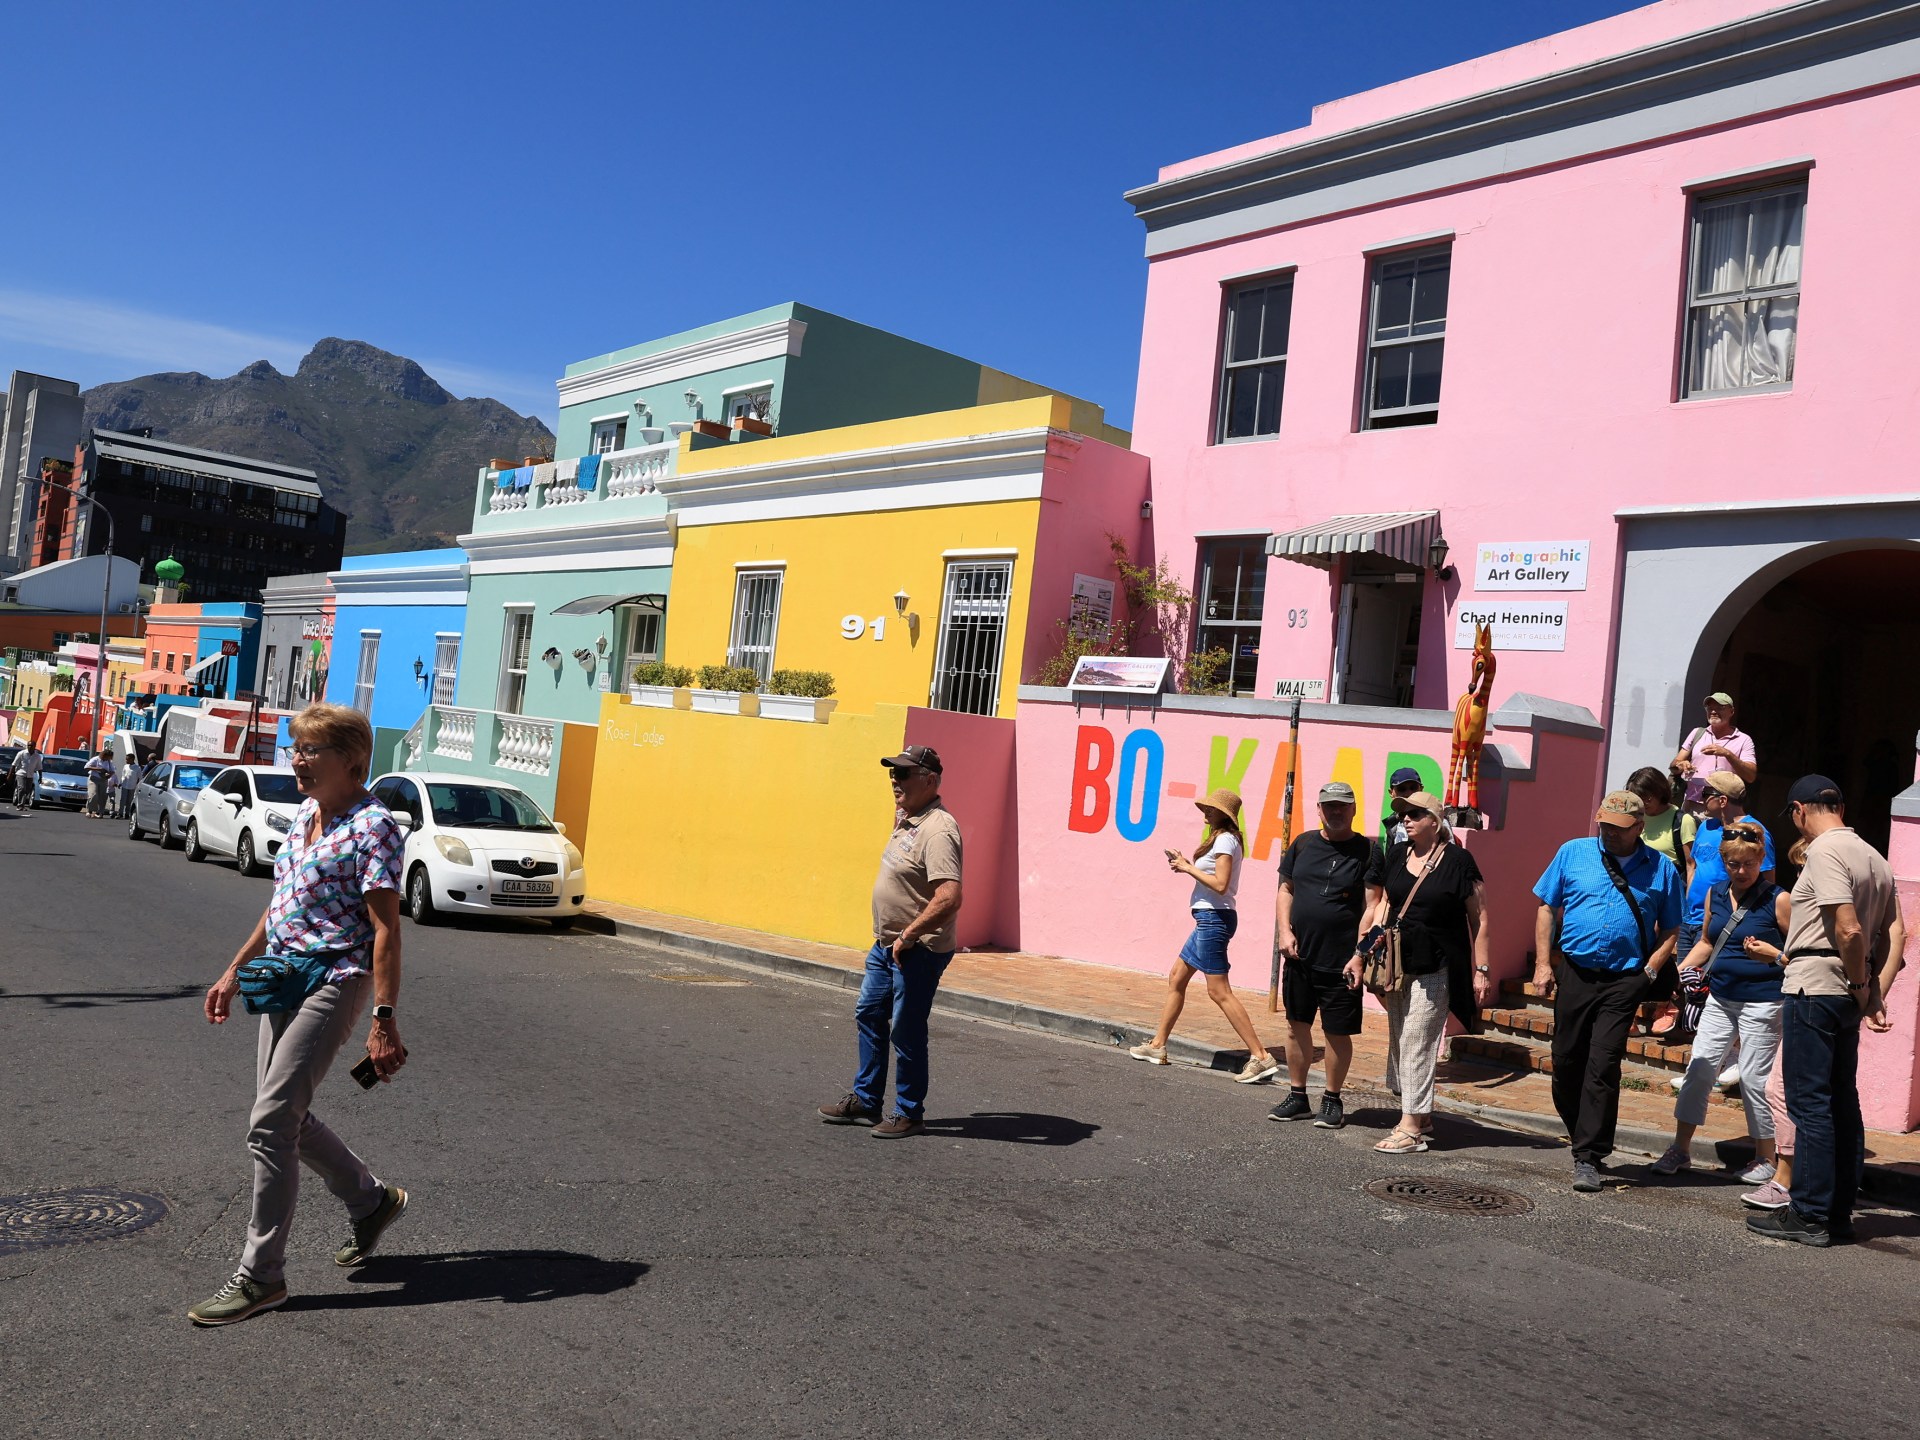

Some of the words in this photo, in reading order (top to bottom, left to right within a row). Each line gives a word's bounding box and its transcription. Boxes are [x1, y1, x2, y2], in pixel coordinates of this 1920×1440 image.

[1482, 549, 1581, 565] Photographic
[1488, 568, 1510, 581] Art
[1514, 567, 1570, 583] Gallery
[1287, 608, 1309, 629] 93
[1460, 612, 1496, 623] Chad
[1502, 612, 1563, 627] Henning
[840, 614, 886, 641] 91
[1458, 632, 1511, 640] PHOTAPHIC
[222, 642, 238, 653] illy
[1276, 681, 1306, 696] WAAL
[1308, 681, 1322, 689] STR
[606, 719, 630, 741] Rose
[633, 721, 665, 747] Lodge
[505, 881, 522, 892] CAA
[526, 882, 552, 893] 58326
